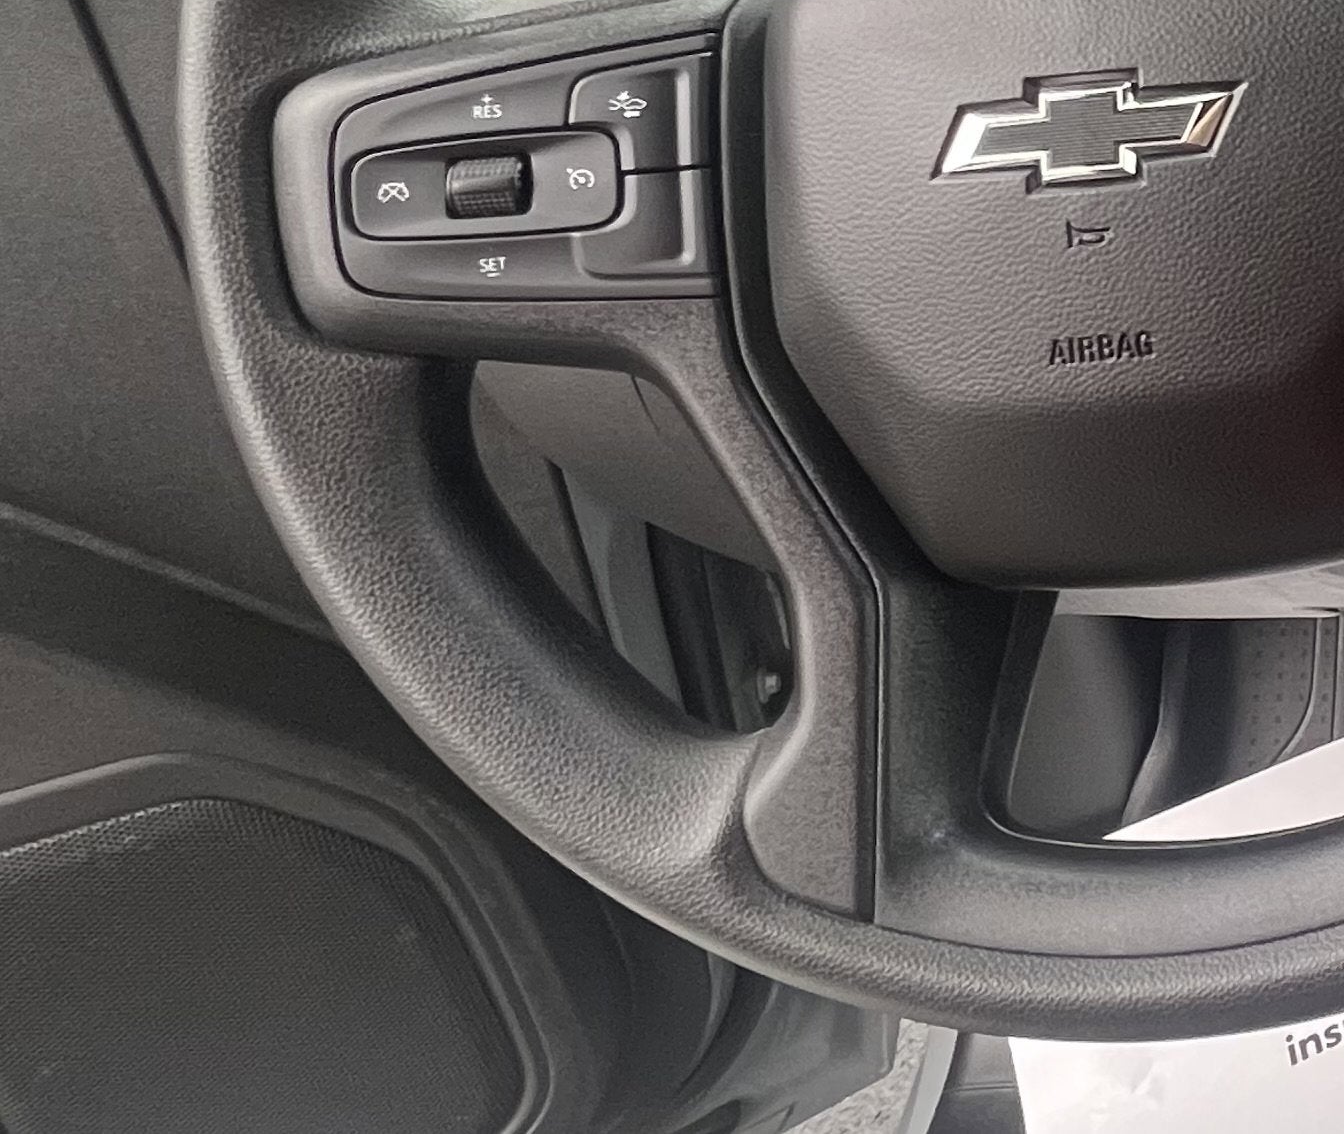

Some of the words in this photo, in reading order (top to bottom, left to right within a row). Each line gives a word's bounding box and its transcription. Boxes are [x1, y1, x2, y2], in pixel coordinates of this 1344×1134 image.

[471, 104, 502, 119] RES
[479, 256, 506, 273] SET
[1050, 330, 1154, 366] AIRBAG
